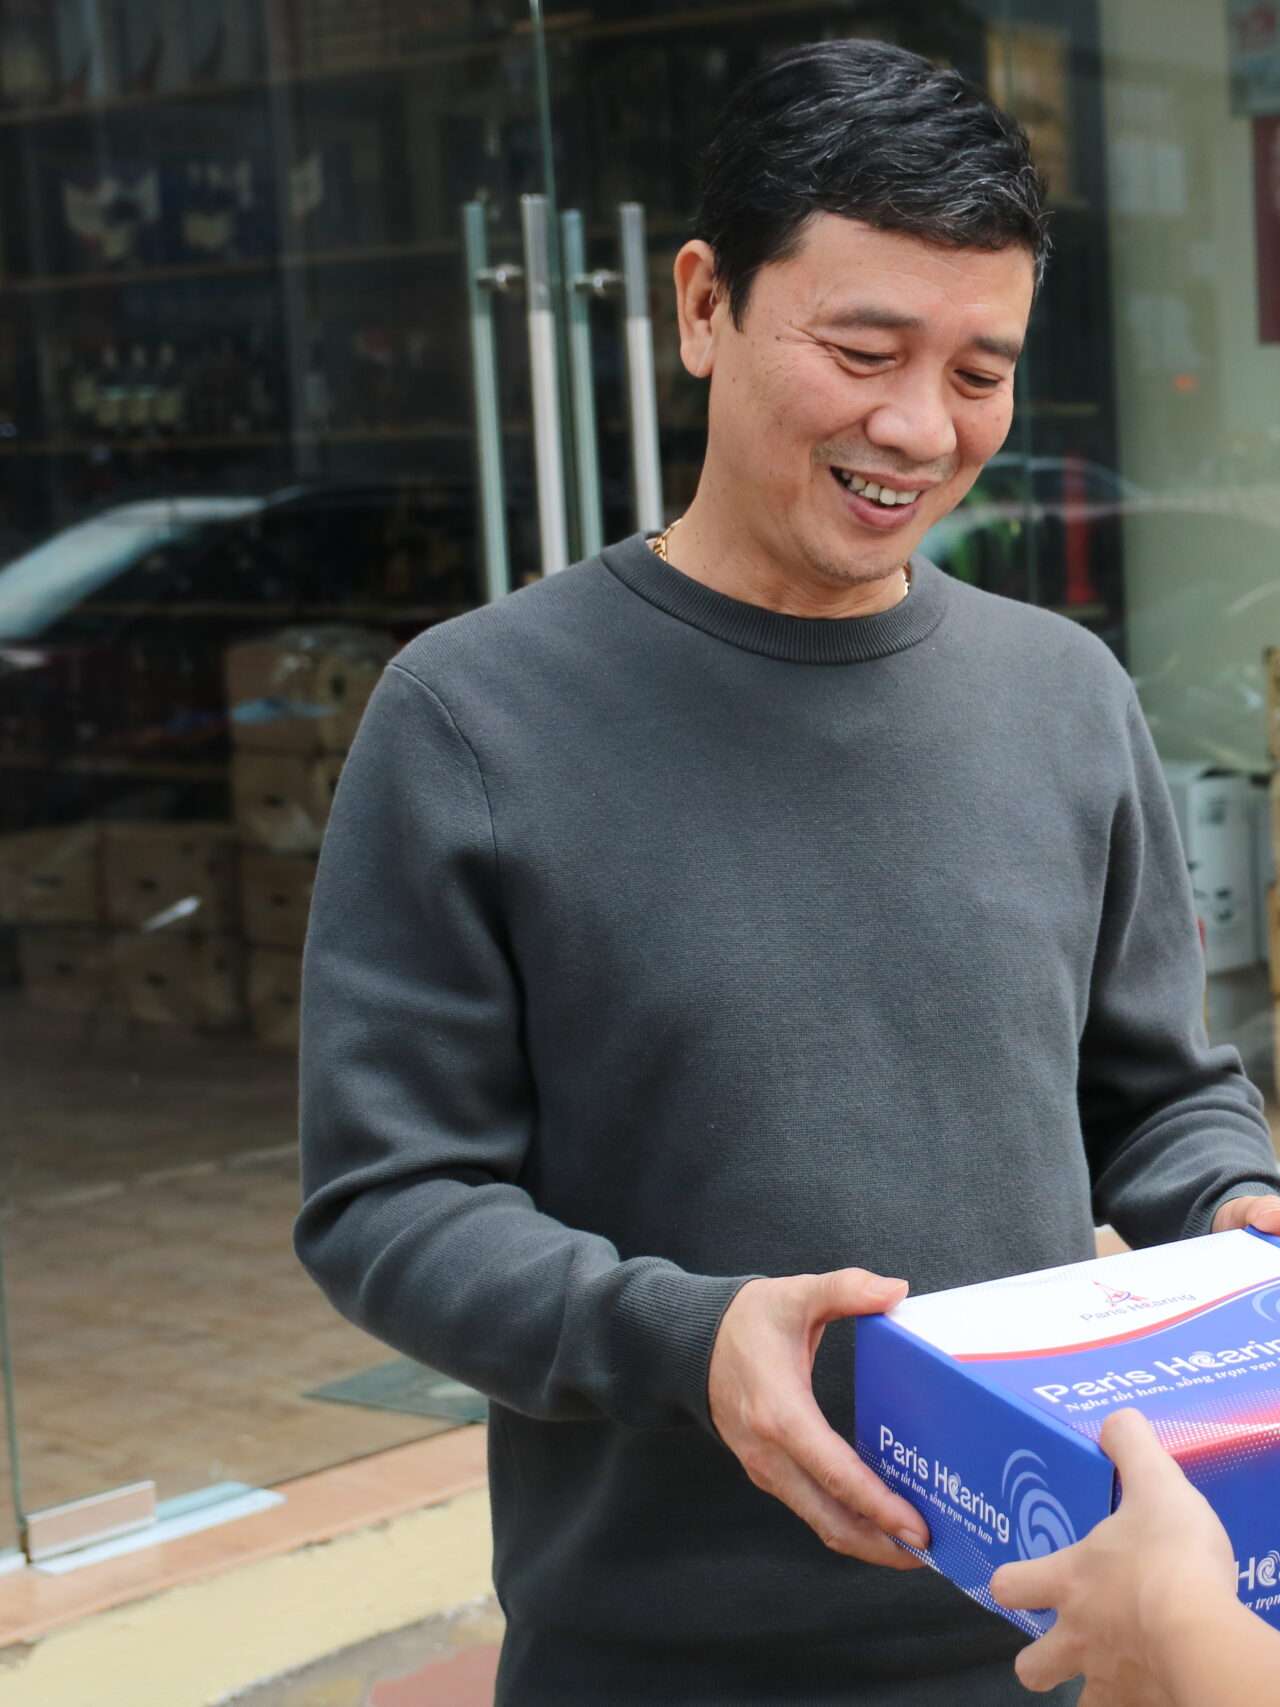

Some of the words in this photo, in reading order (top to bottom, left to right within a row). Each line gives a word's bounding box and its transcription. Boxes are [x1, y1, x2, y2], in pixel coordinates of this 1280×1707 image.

[1033, 1370, 1157, 1403] Paris
[1064, 1395, 1110, 1413] Nghe
[880, 1457, 901, 1478] Nghe
[880, 1424, 929, 1480] Paris
[934, 1460, 1010, 1544] Hearing
